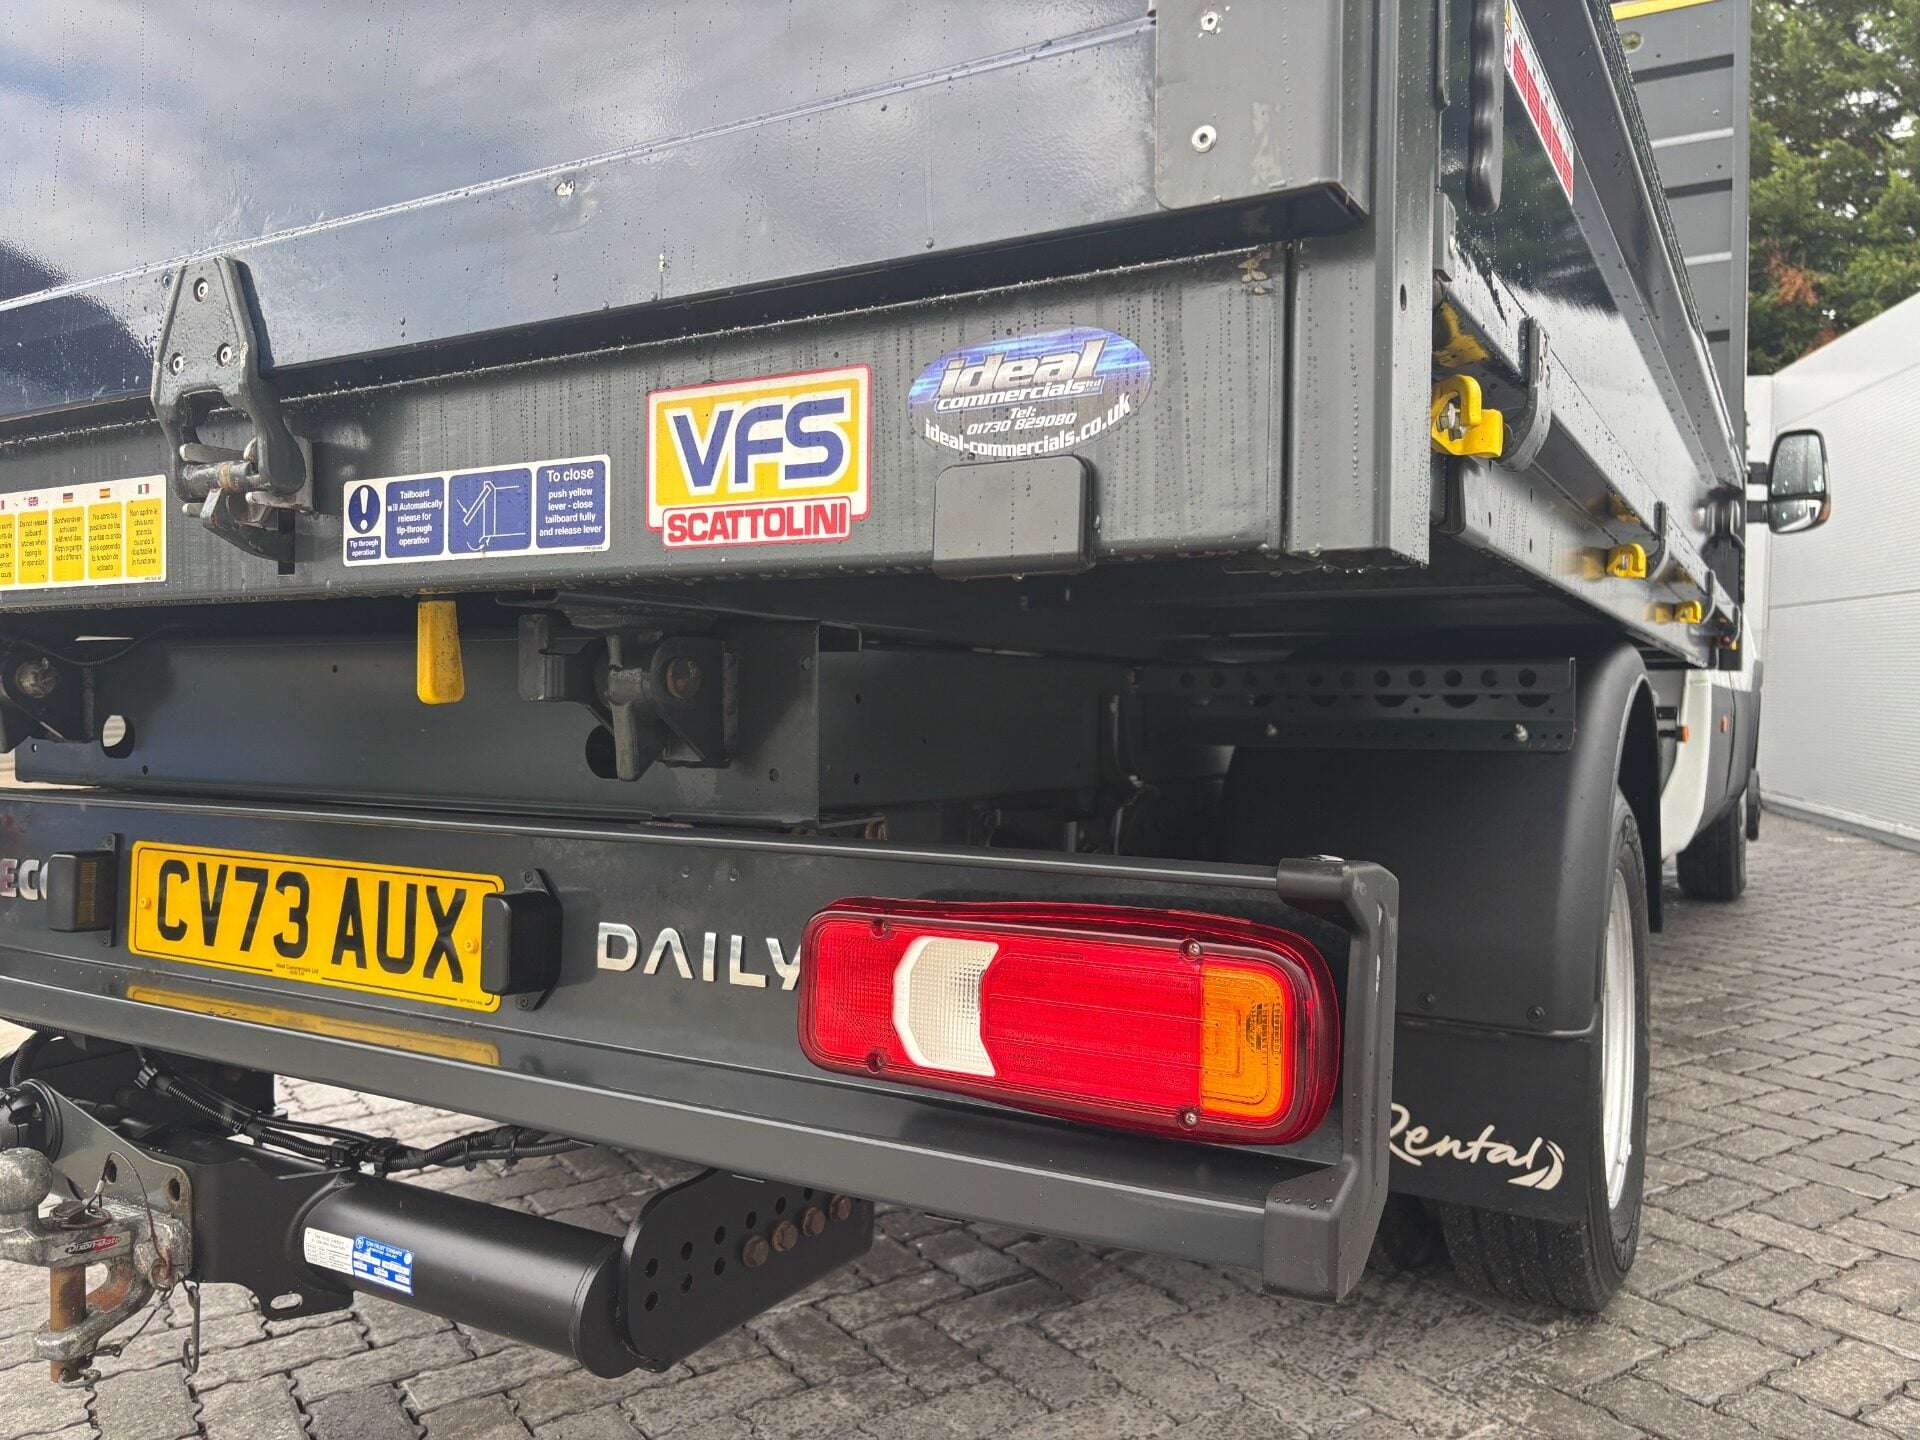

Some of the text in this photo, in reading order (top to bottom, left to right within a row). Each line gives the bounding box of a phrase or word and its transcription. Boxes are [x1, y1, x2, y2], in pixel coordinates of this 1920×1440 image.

[937, 338, 1106, 399] ideal
[937, 380, 1086, 412] commercials
[1010, 405, 1036, 419] Tel:
[924, 393, 1132, 457] ideal-commercials.co.uk
[966, 412, 1078, 436] 01730 829080
[672, 396, 845, 488] VFS
[546, 467, 595, 482] To close
[400, 488, 430, 500] Tailboard
[548, 487, 593, 501] push yellow
[387, 499, 443, 512] will Automatically
[548, 502, 566, 511] lever
[572, 500, 594, 510] close
[397, 512, 432, 523] release for
[545, 511, 596, 524] tailboard fully
[667, 503, 847, 543] SCATTOLINI
[396, 523, 433, 536] tip-through
[539, 524, 602, 537] and release lever
[349, 538, 379, 549] Tip through
[398, 536, 430, 547] operation
[351, 548, 376, 558] operation
[156, 859, 467, 983] CV73 AUX
[597, 922, 801, 991] DAILY
